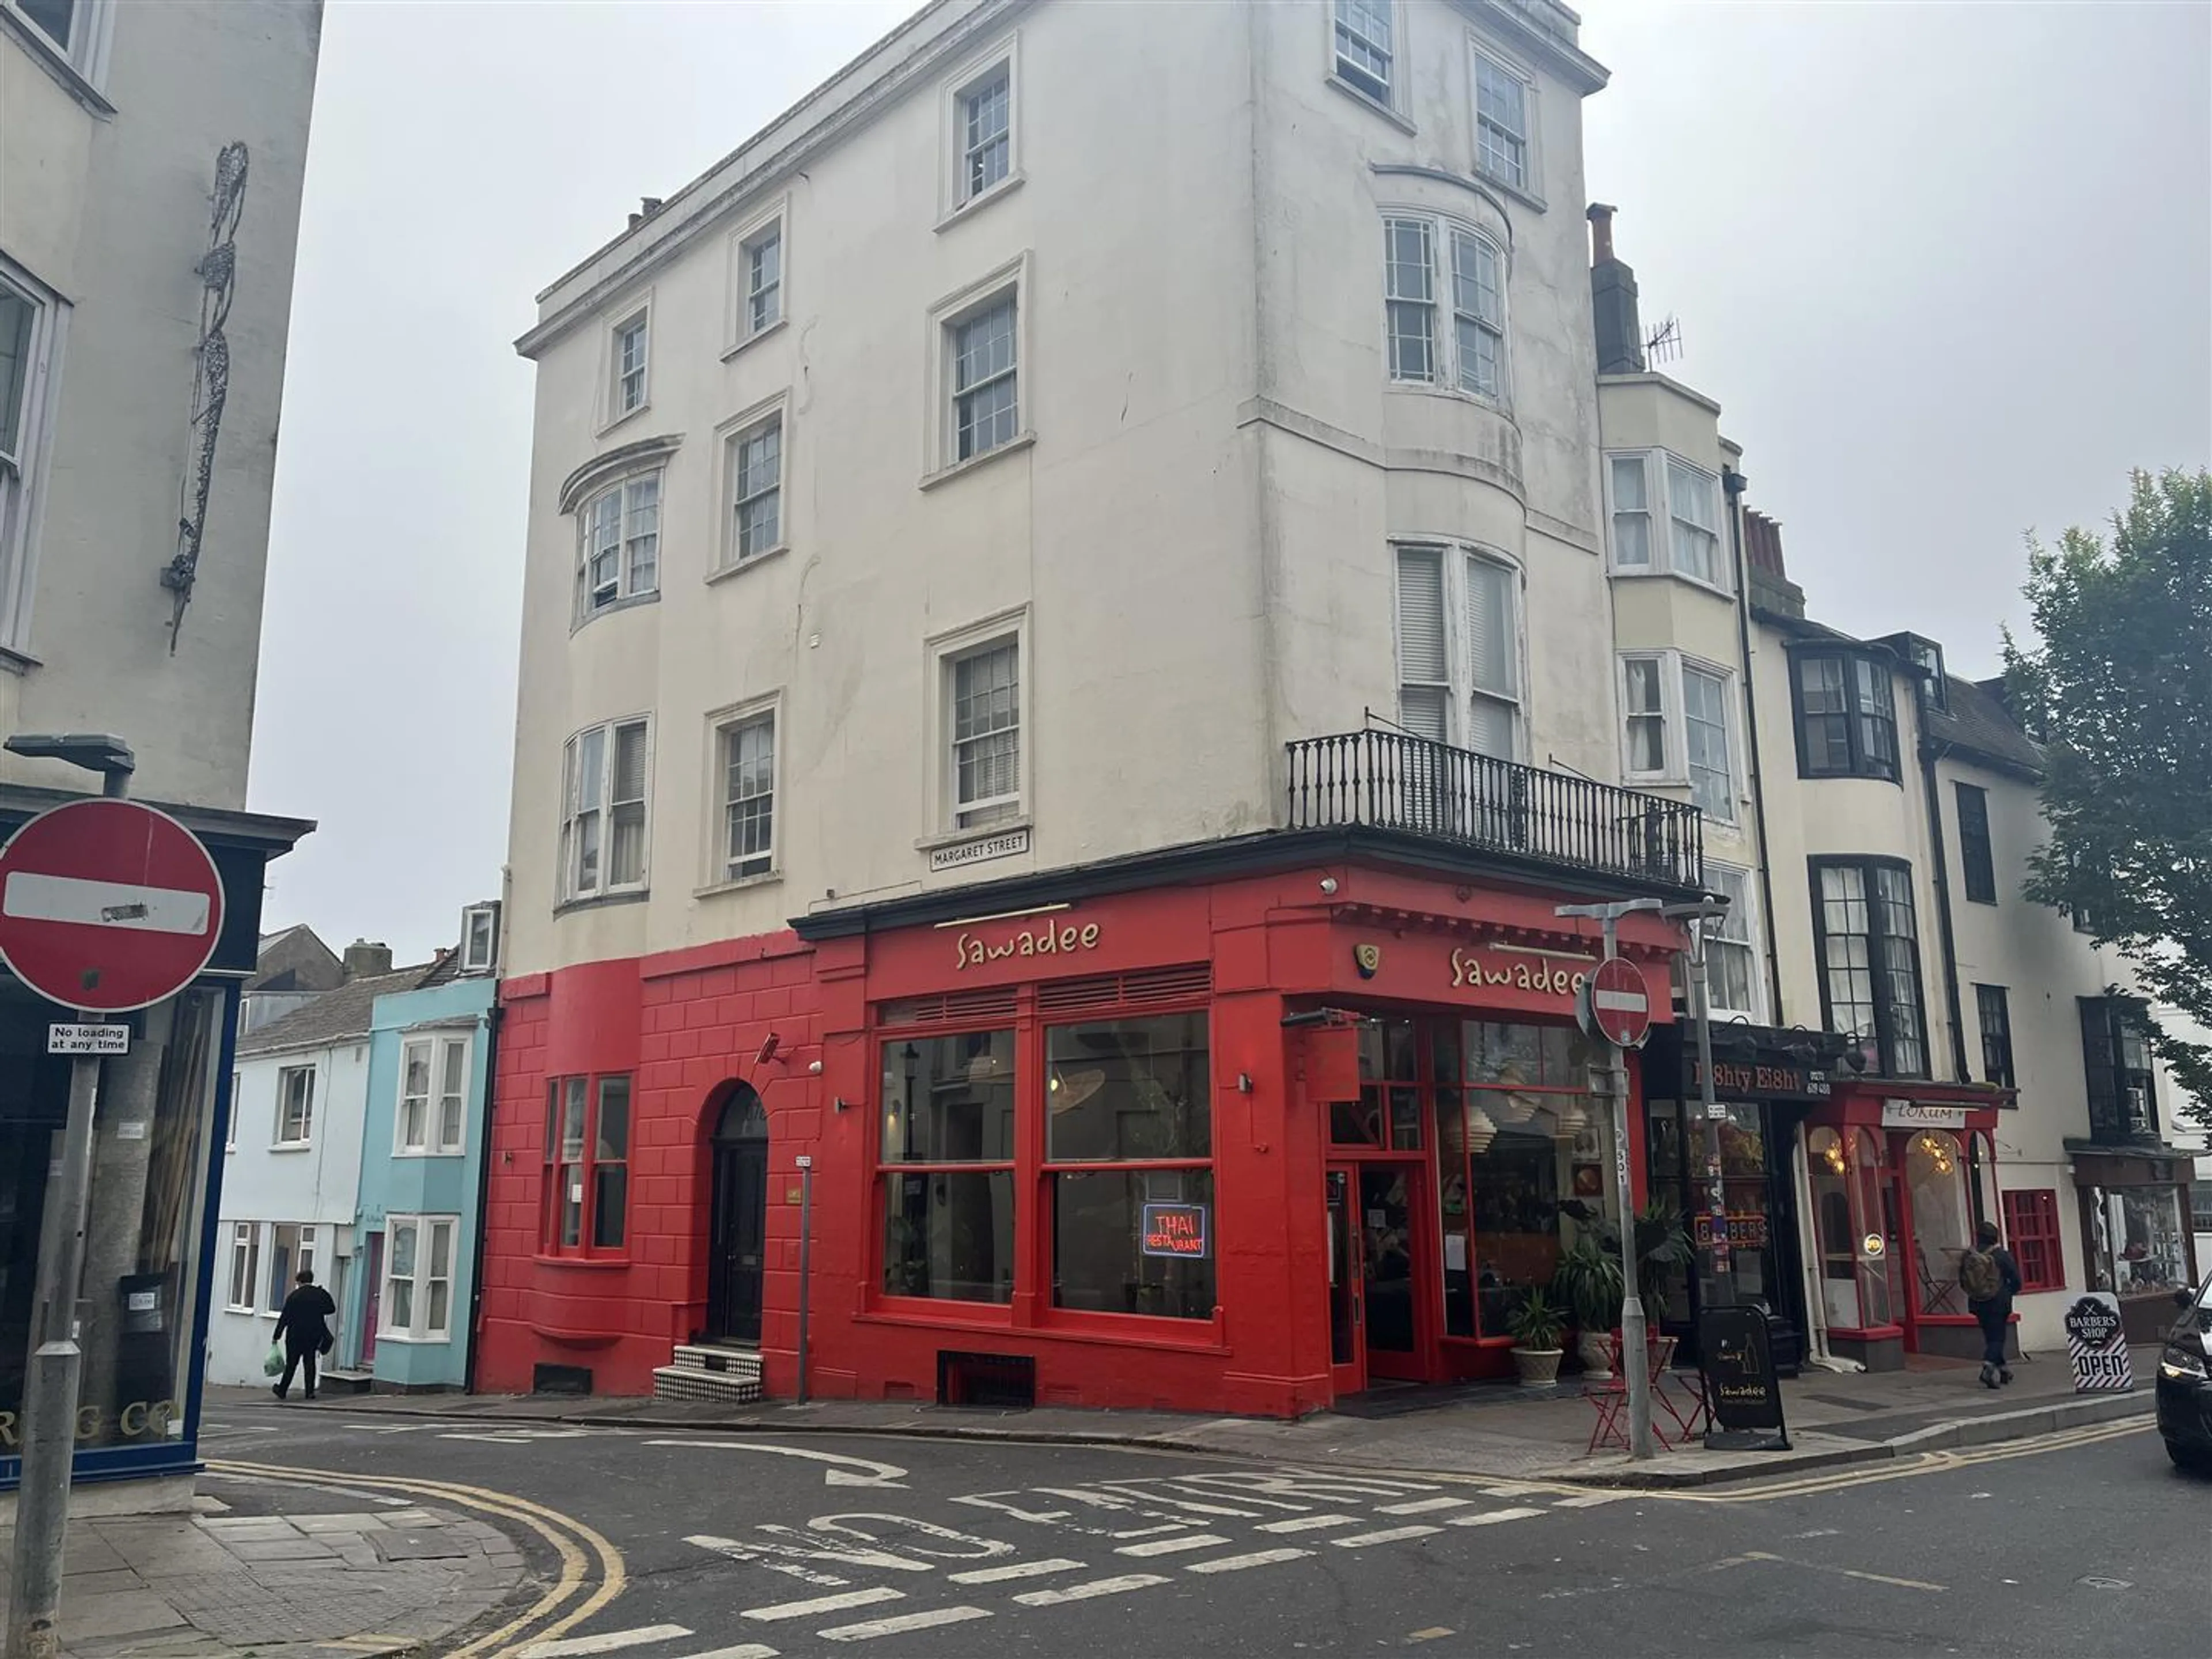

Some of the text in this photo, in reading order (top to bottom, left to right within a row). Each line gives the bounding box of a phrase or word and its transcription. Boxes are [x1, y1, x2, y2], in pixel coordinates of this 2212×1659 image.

[933, 836, 1023, 864] MARGARET STREET
[956, 919, 1099, 969] Sawadee
[1451, 948, 1585, 996] Sawadee
[55, 1027, 123, 1039] No loading
[52, 1039, 125, 1051] at any time
[1155, 1215, 1194, 1235] THAI
[2069, 1316, 2116, 1327] BARBERS
[2082, 1327, 2108, 1339] SHOP
[2078, 1355, 2124, 1376] OPEN
